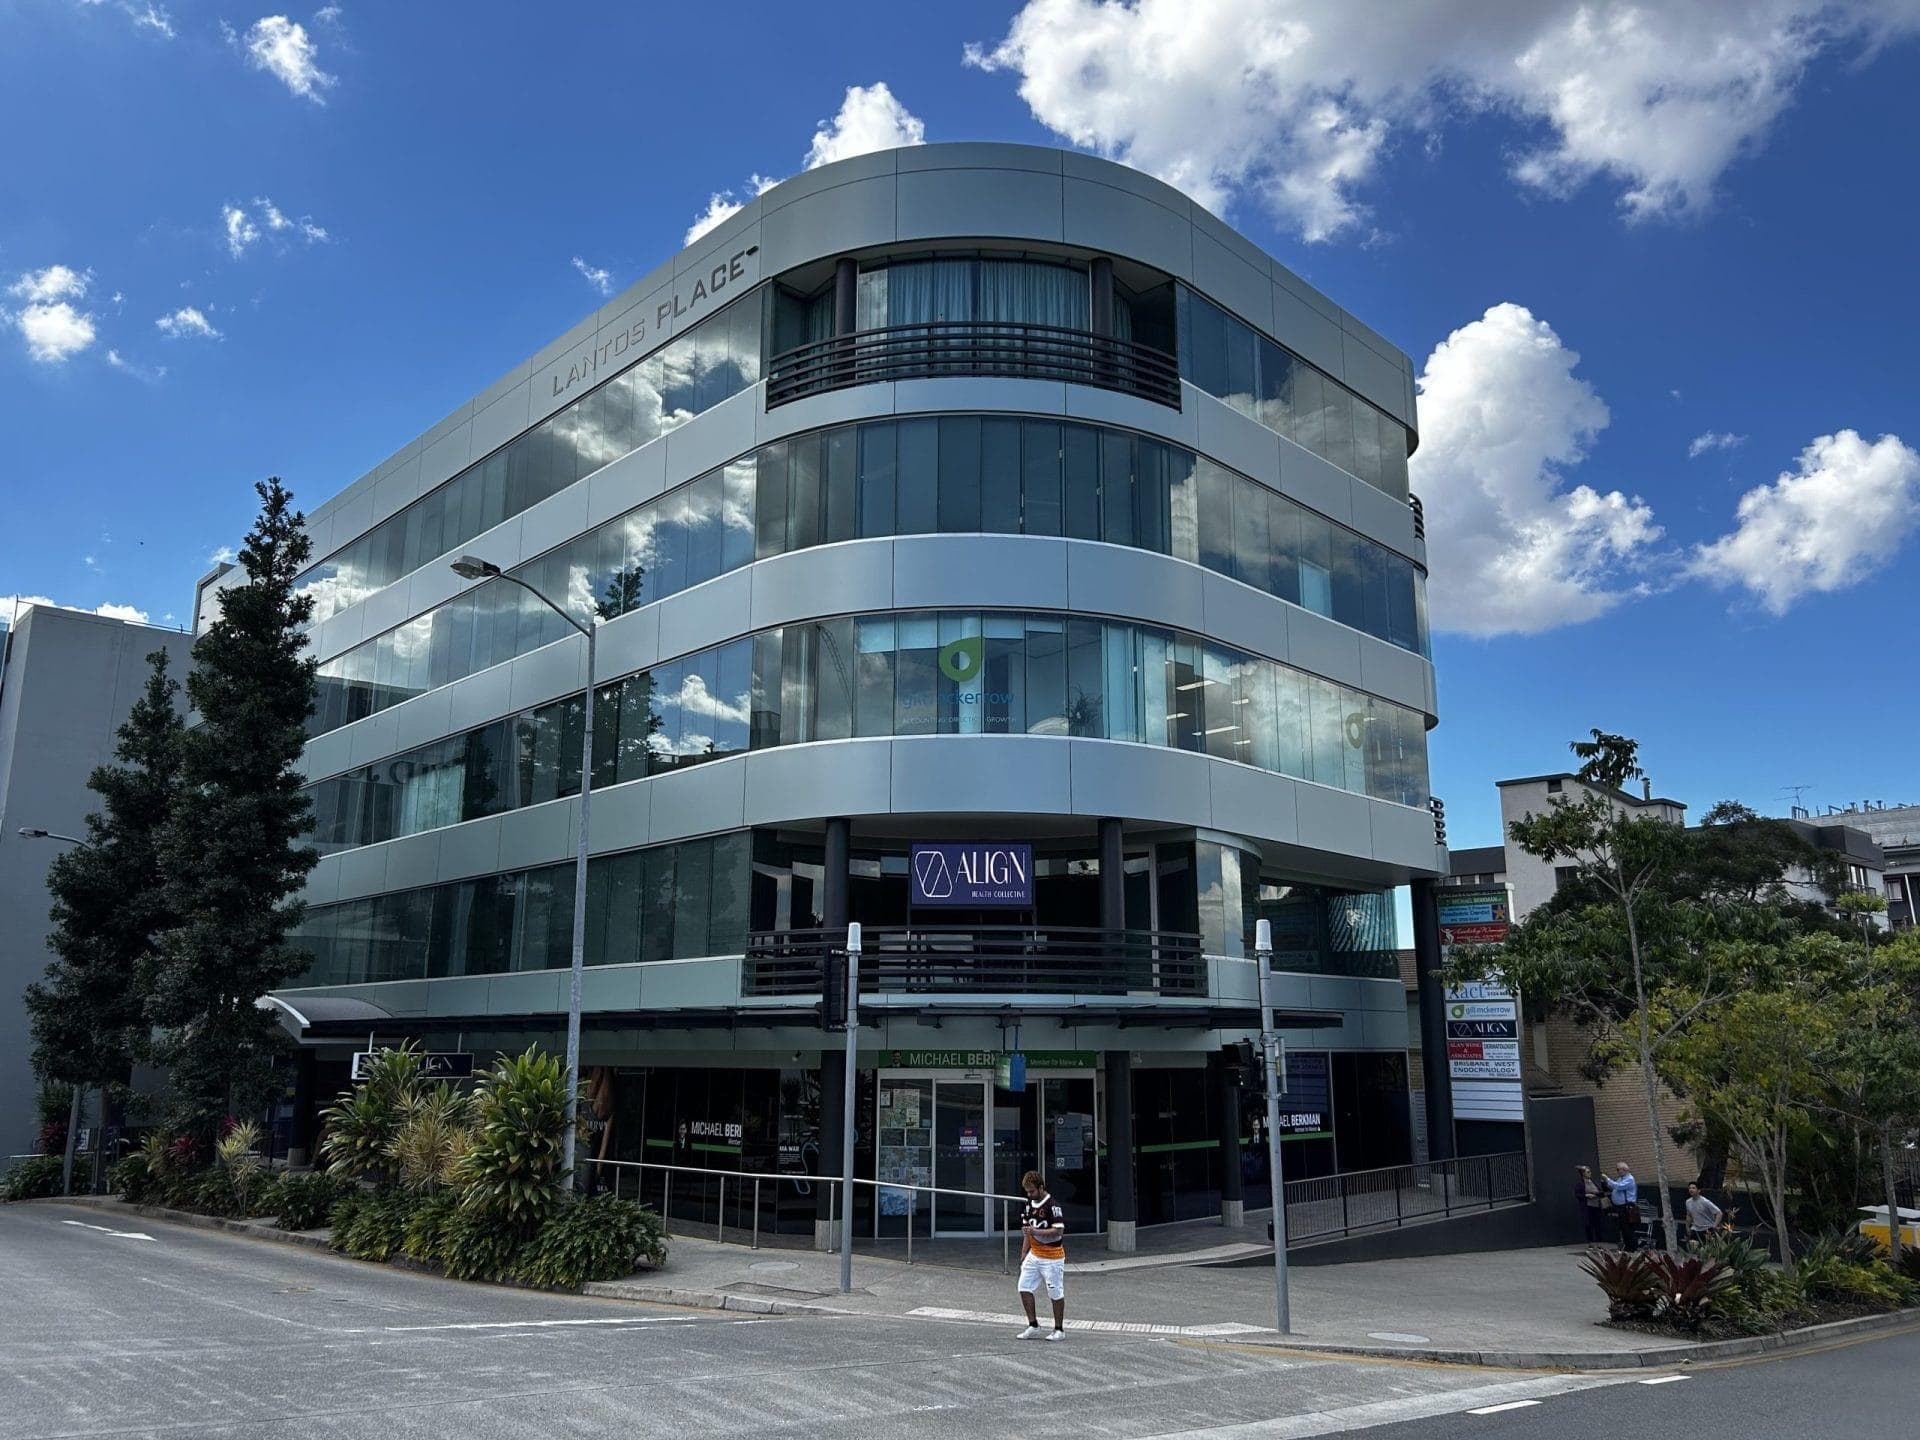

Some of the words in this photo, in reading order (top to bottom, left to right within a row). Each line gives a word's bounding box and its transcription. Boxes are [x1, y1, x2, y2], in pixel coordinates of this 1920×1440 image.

[552, 317, 646, 397] LANTOS
[656, 249, 746, 329] PLACE
[955, 850, 1026, 885] ALIGN
[993, 890, 1026, 898] COLLECTIVE
[1473, 1022, 1508, 1033] ALIGN
[909, 1052, 965, 1066] MICHAEL
[1291, 1113, 1321, 1126] BERKMAN
[690, 1121, 723, 1137] MICHAEL
